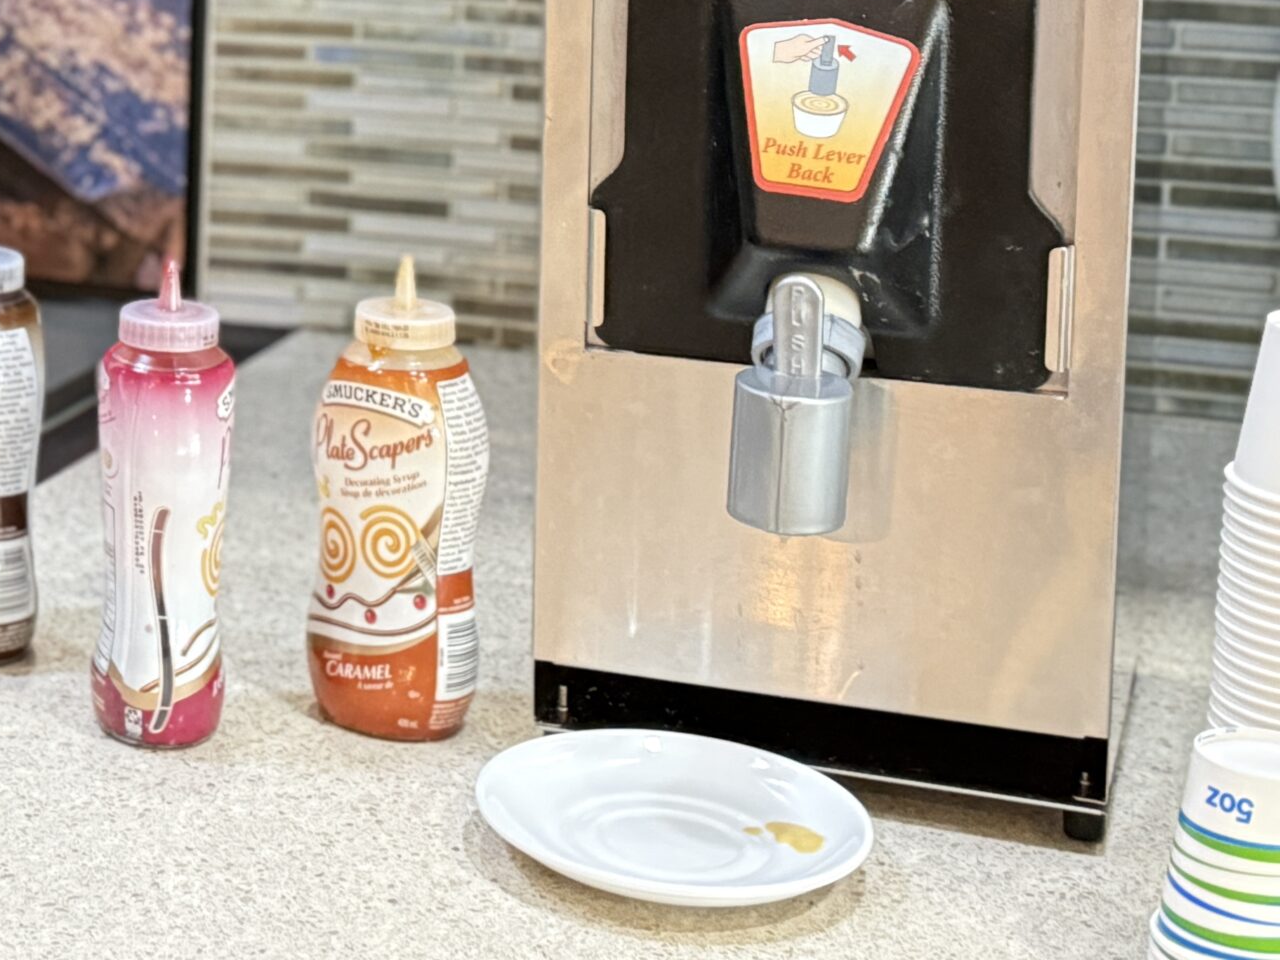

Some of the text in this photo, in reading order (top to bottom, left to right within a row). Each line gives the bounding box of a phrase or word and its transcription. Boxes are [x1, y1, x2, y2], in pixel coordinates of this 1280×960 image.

[762, 136, 866, 166] Push Lever
[787, 162, 835, 184] Back
[325, 383, 424, 419] SMUCKER'S
[325, 660, 393, 681] CARAMEL
